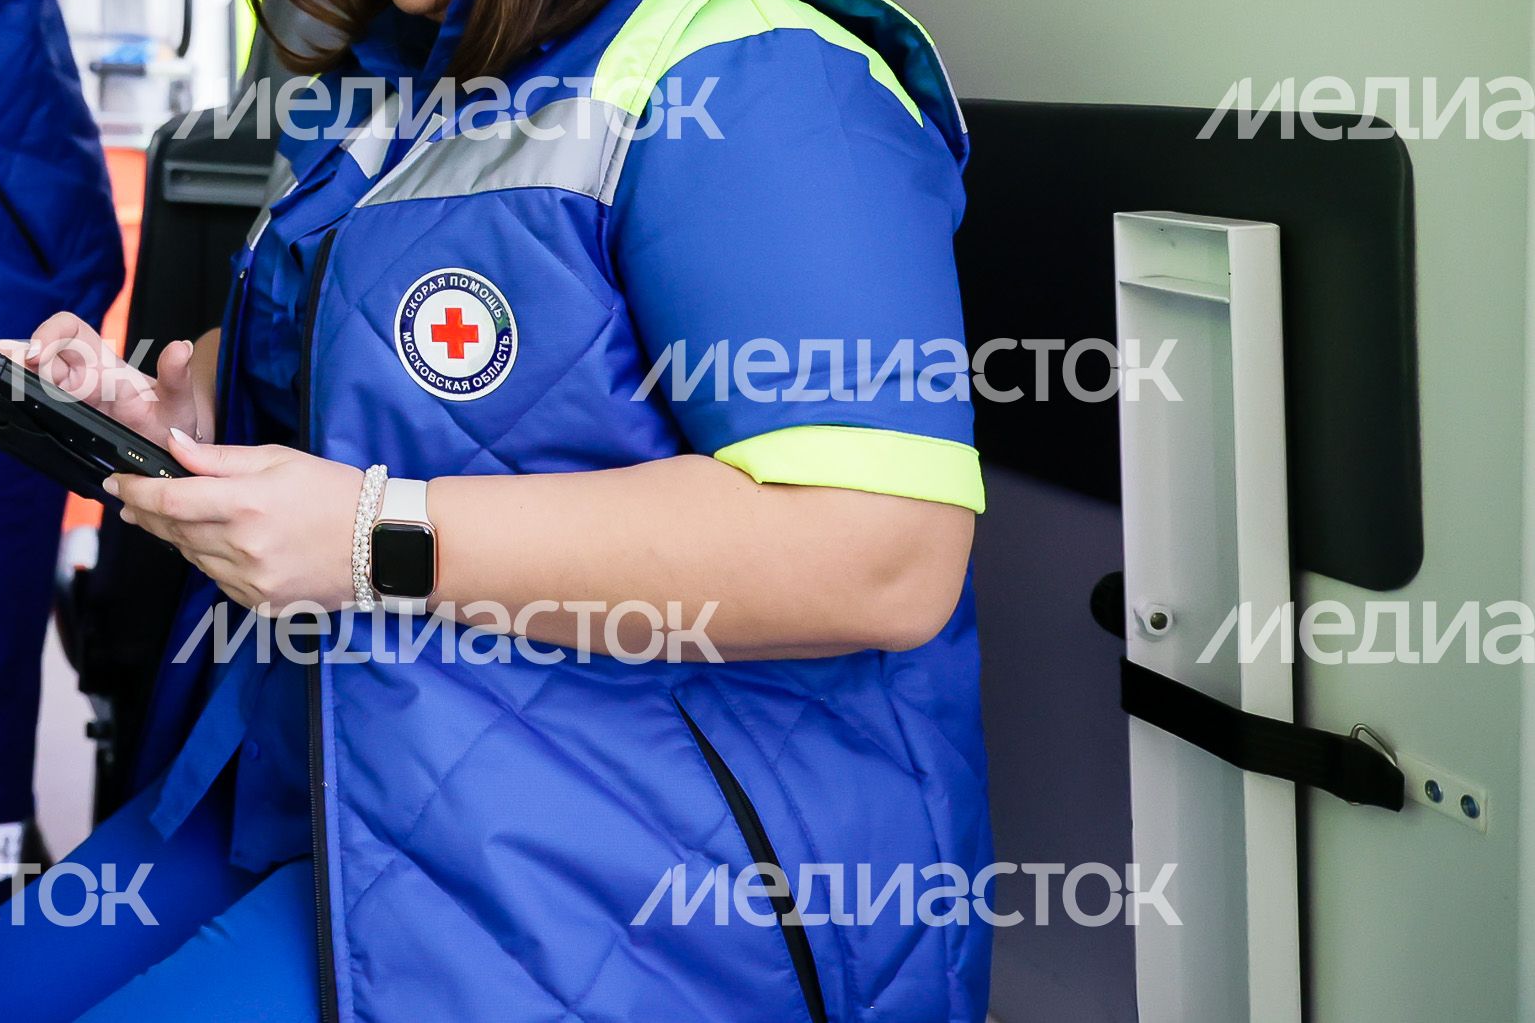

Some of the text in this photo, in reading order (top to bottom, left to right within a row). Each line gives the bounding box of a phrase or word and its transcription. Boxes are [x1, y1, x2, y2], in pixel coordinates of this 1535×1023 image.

[405, 275, 504, 319] СКОРАЯ ПОМОЩЬ
[402, 331, 512, 391] МОСКОВСКАЯ ОБЛАСТЬ
